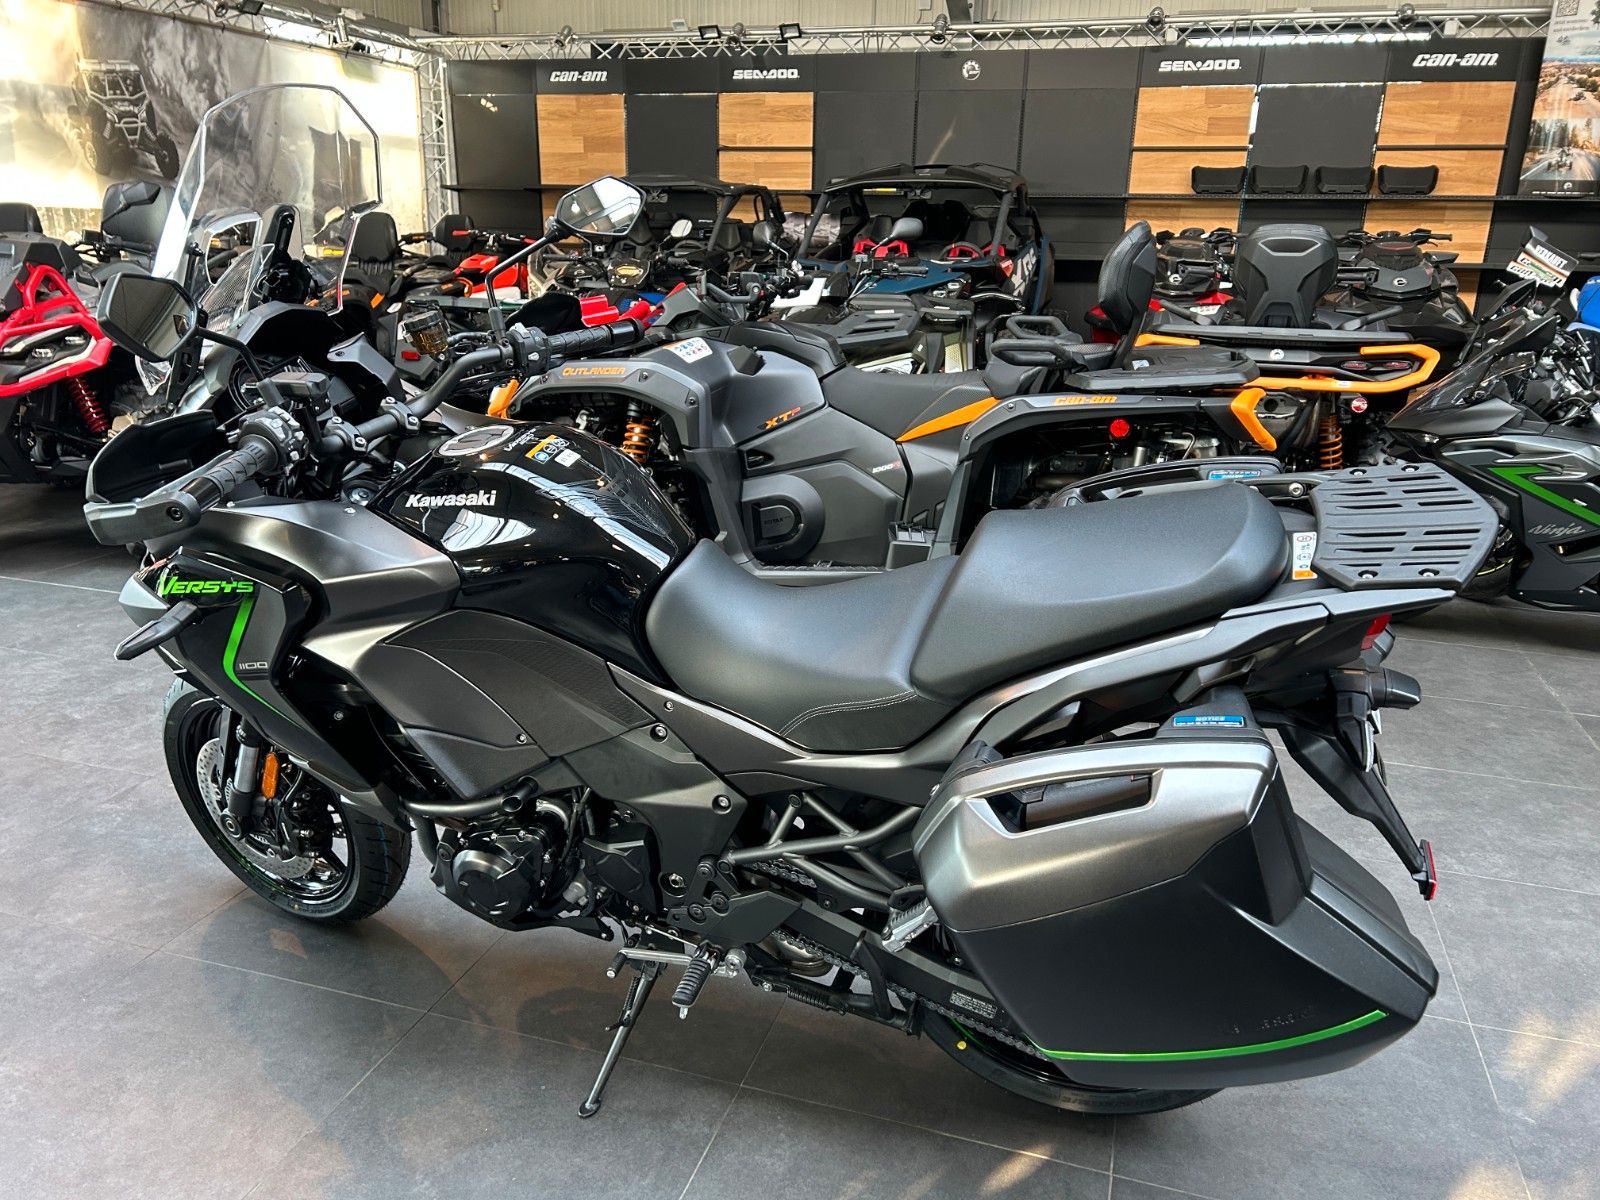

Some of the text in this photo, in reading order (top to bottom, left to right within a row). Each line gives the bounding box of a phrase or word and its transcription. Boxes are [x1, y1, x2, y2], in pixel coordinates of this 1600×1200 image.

[1412, 53, 1499, 67] can-am
[549, 70, 608, 82] can-am
[562, 367, 626, 377] OUTLANDER
[404, 489, 497, 508] Kawasaki
[1528, 522, 1586, 538] Ninja
[159, 575, 255, 596] VERSYS
[238, 661, 269, 671] 1100
